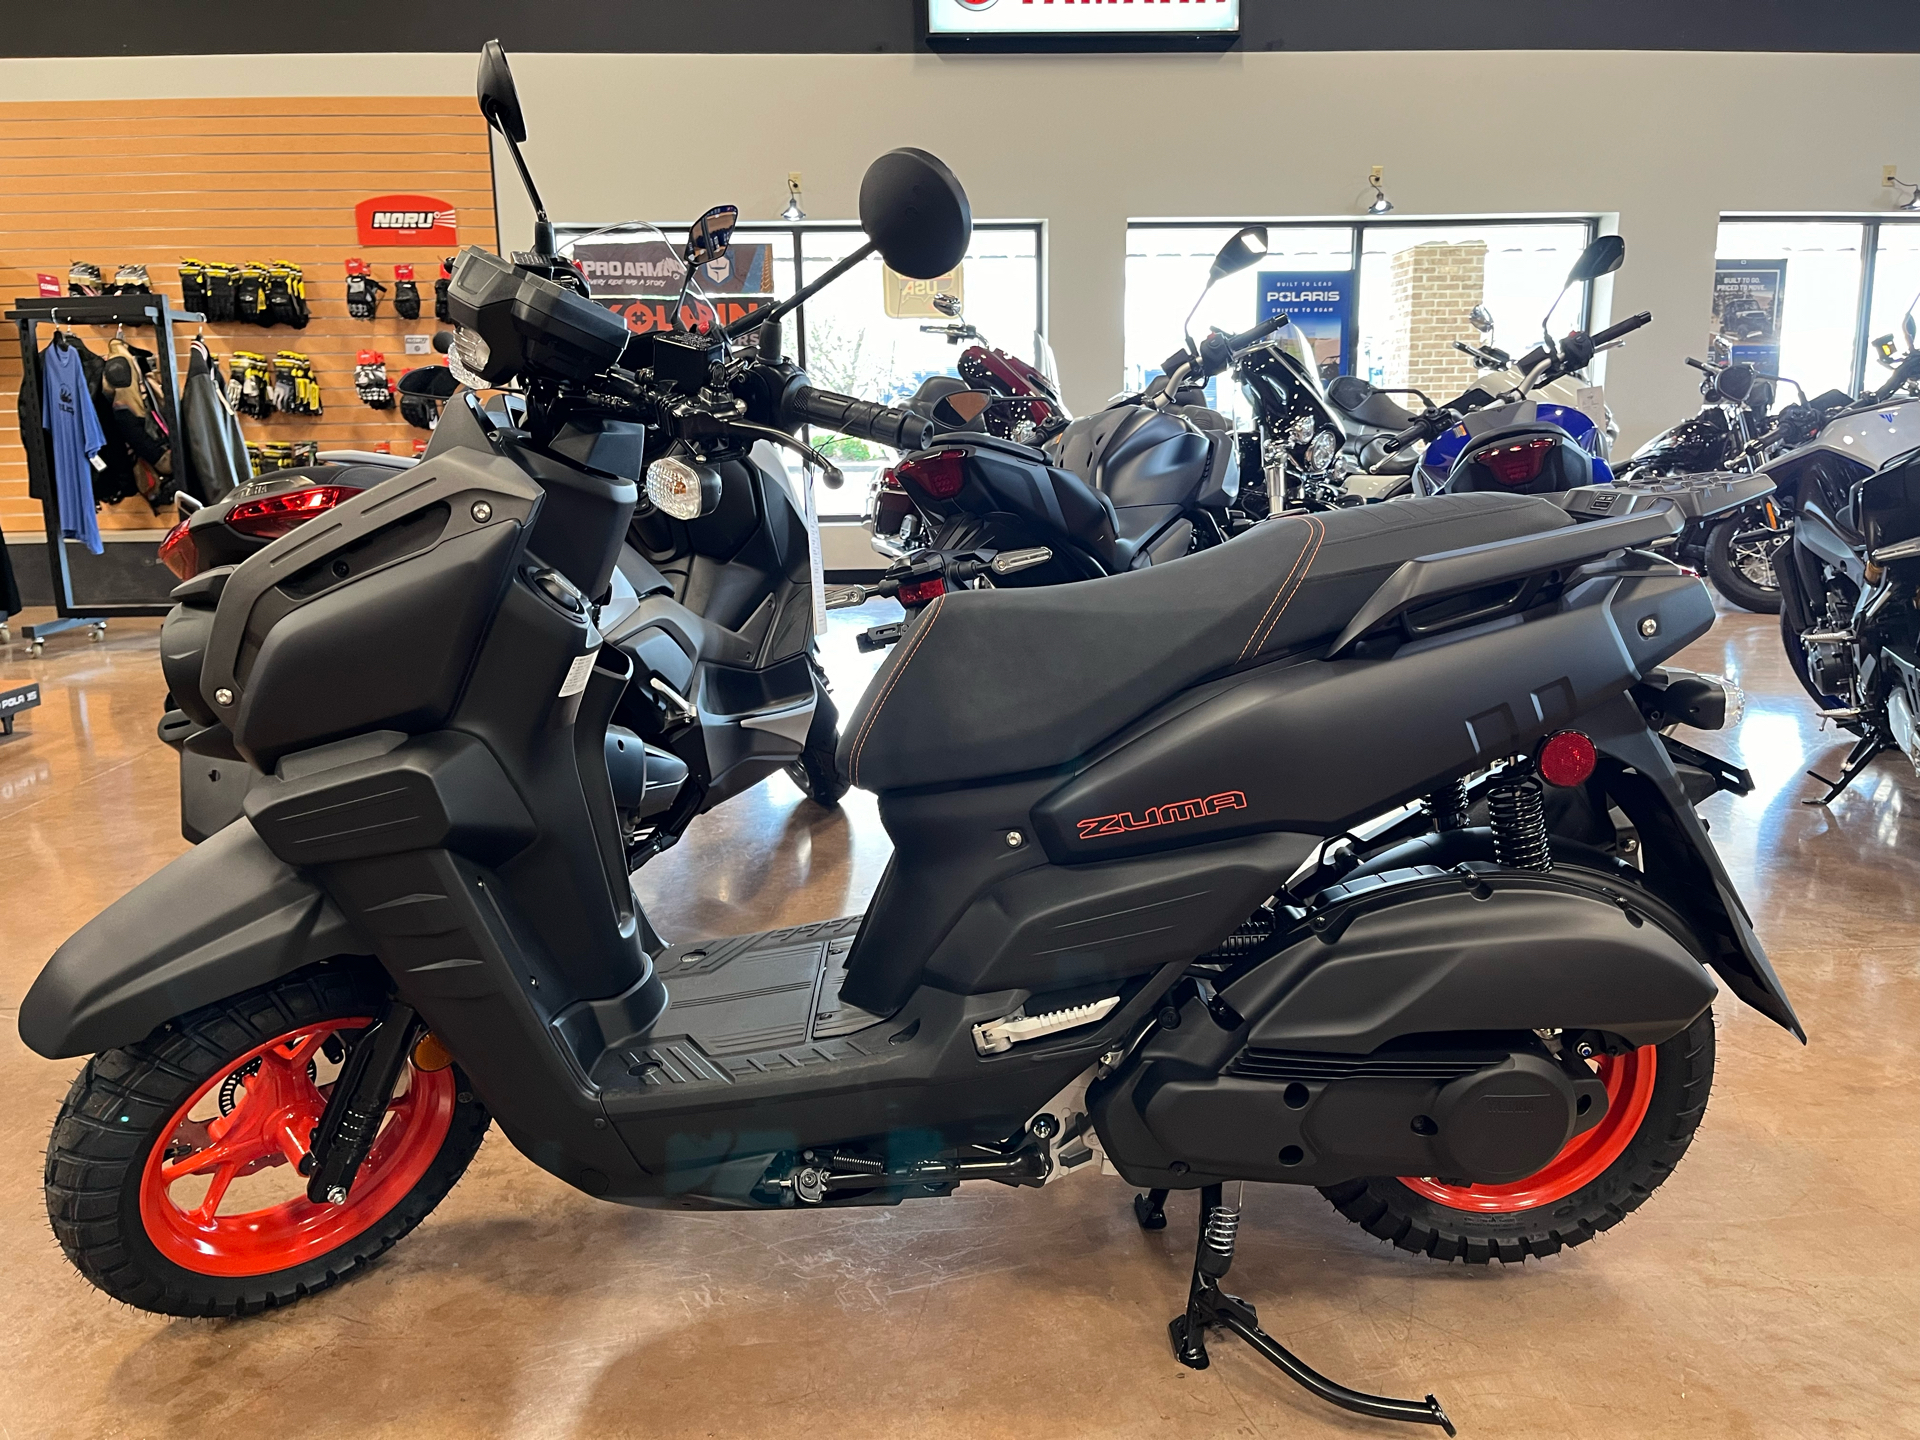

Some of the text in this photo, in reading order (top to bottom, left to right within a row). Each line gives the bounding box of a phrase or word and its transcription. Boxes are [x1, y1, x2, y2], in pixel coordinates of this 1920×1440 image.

[373, 212, 434, 228] NORU
[582, 261, 622, 276] PRO
[1267, 291, 1340, 302] POLARIS
[1077, 790, 1247, 840] ZUMA
